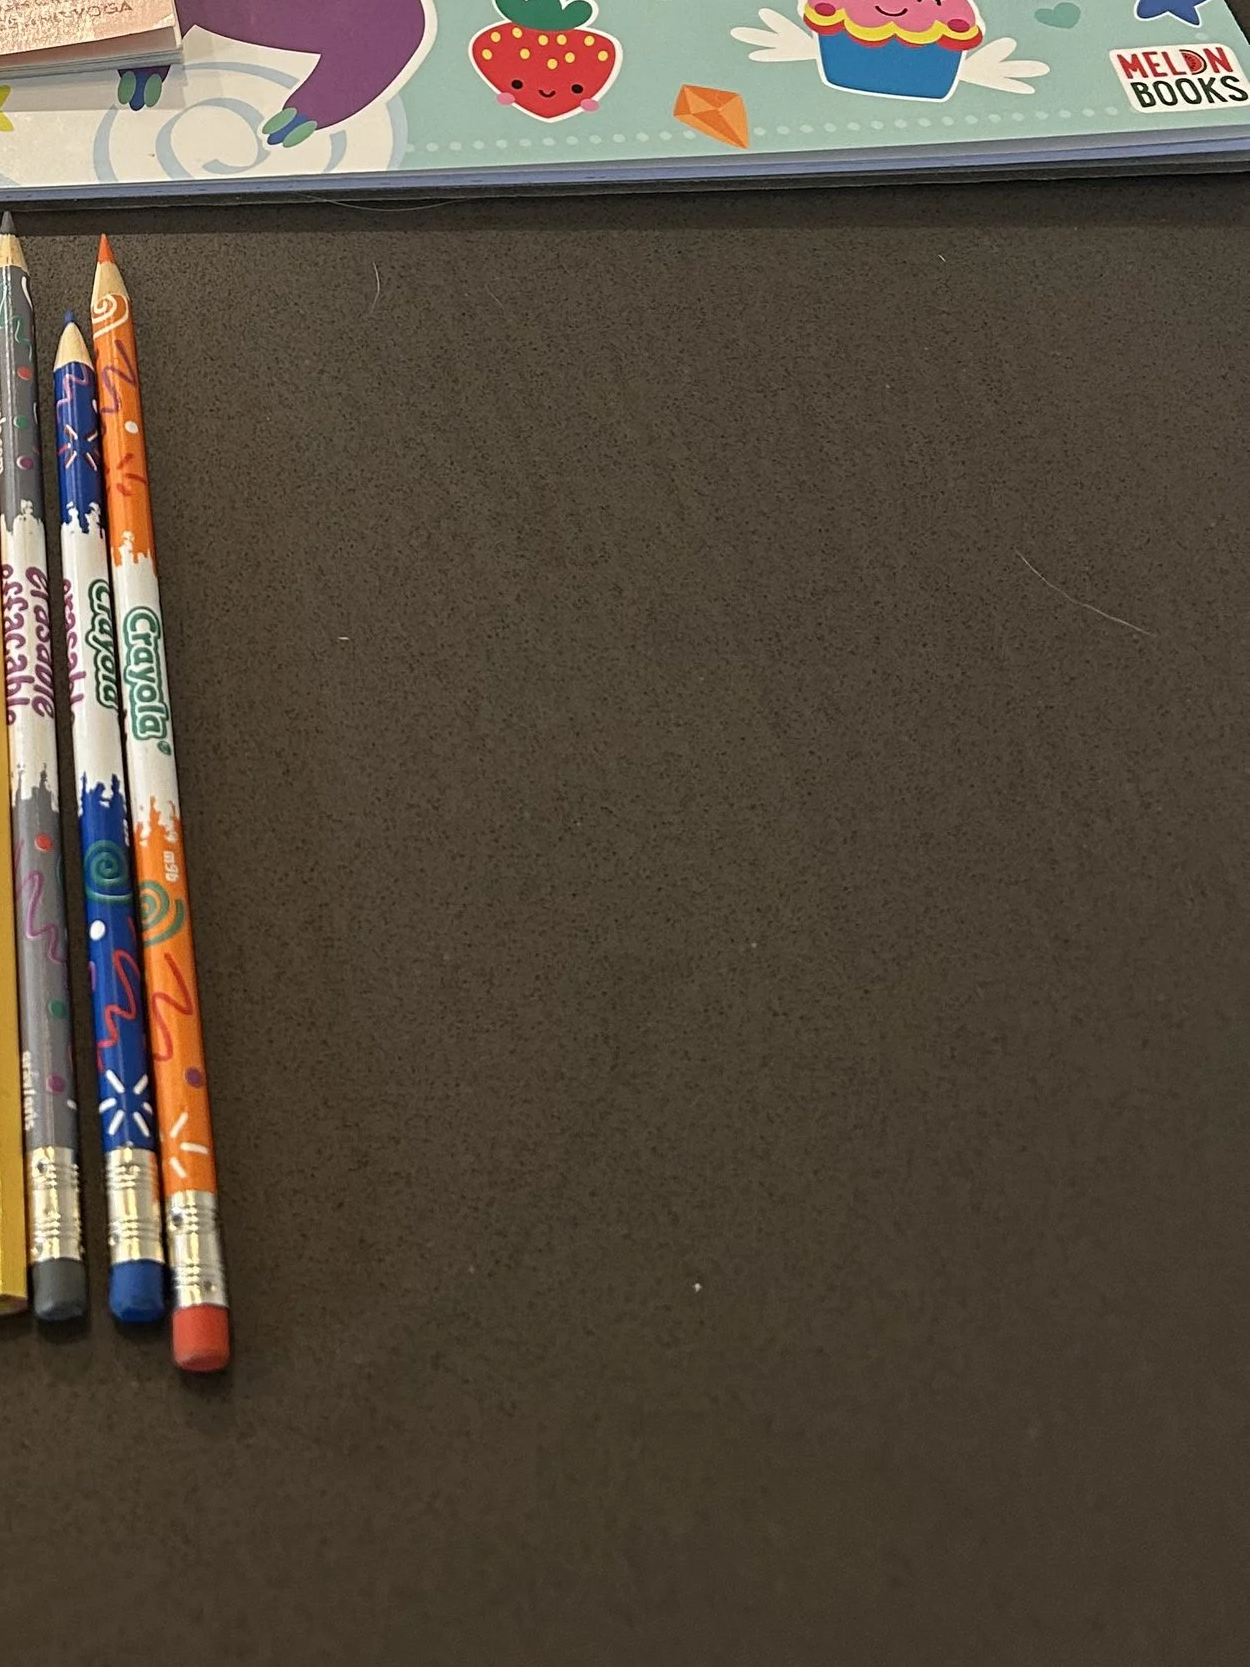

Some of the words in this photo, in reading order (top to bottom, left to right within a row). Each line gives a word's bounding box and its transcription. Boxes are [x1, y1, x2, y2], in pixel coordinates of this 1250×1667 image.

[1117, 47, 1234, 80] MELON
[1130, 75, 1249, 108] BOOKS
[89, 582, 119, 707] Crayola
[126, 609, 169, 738] Crayola
